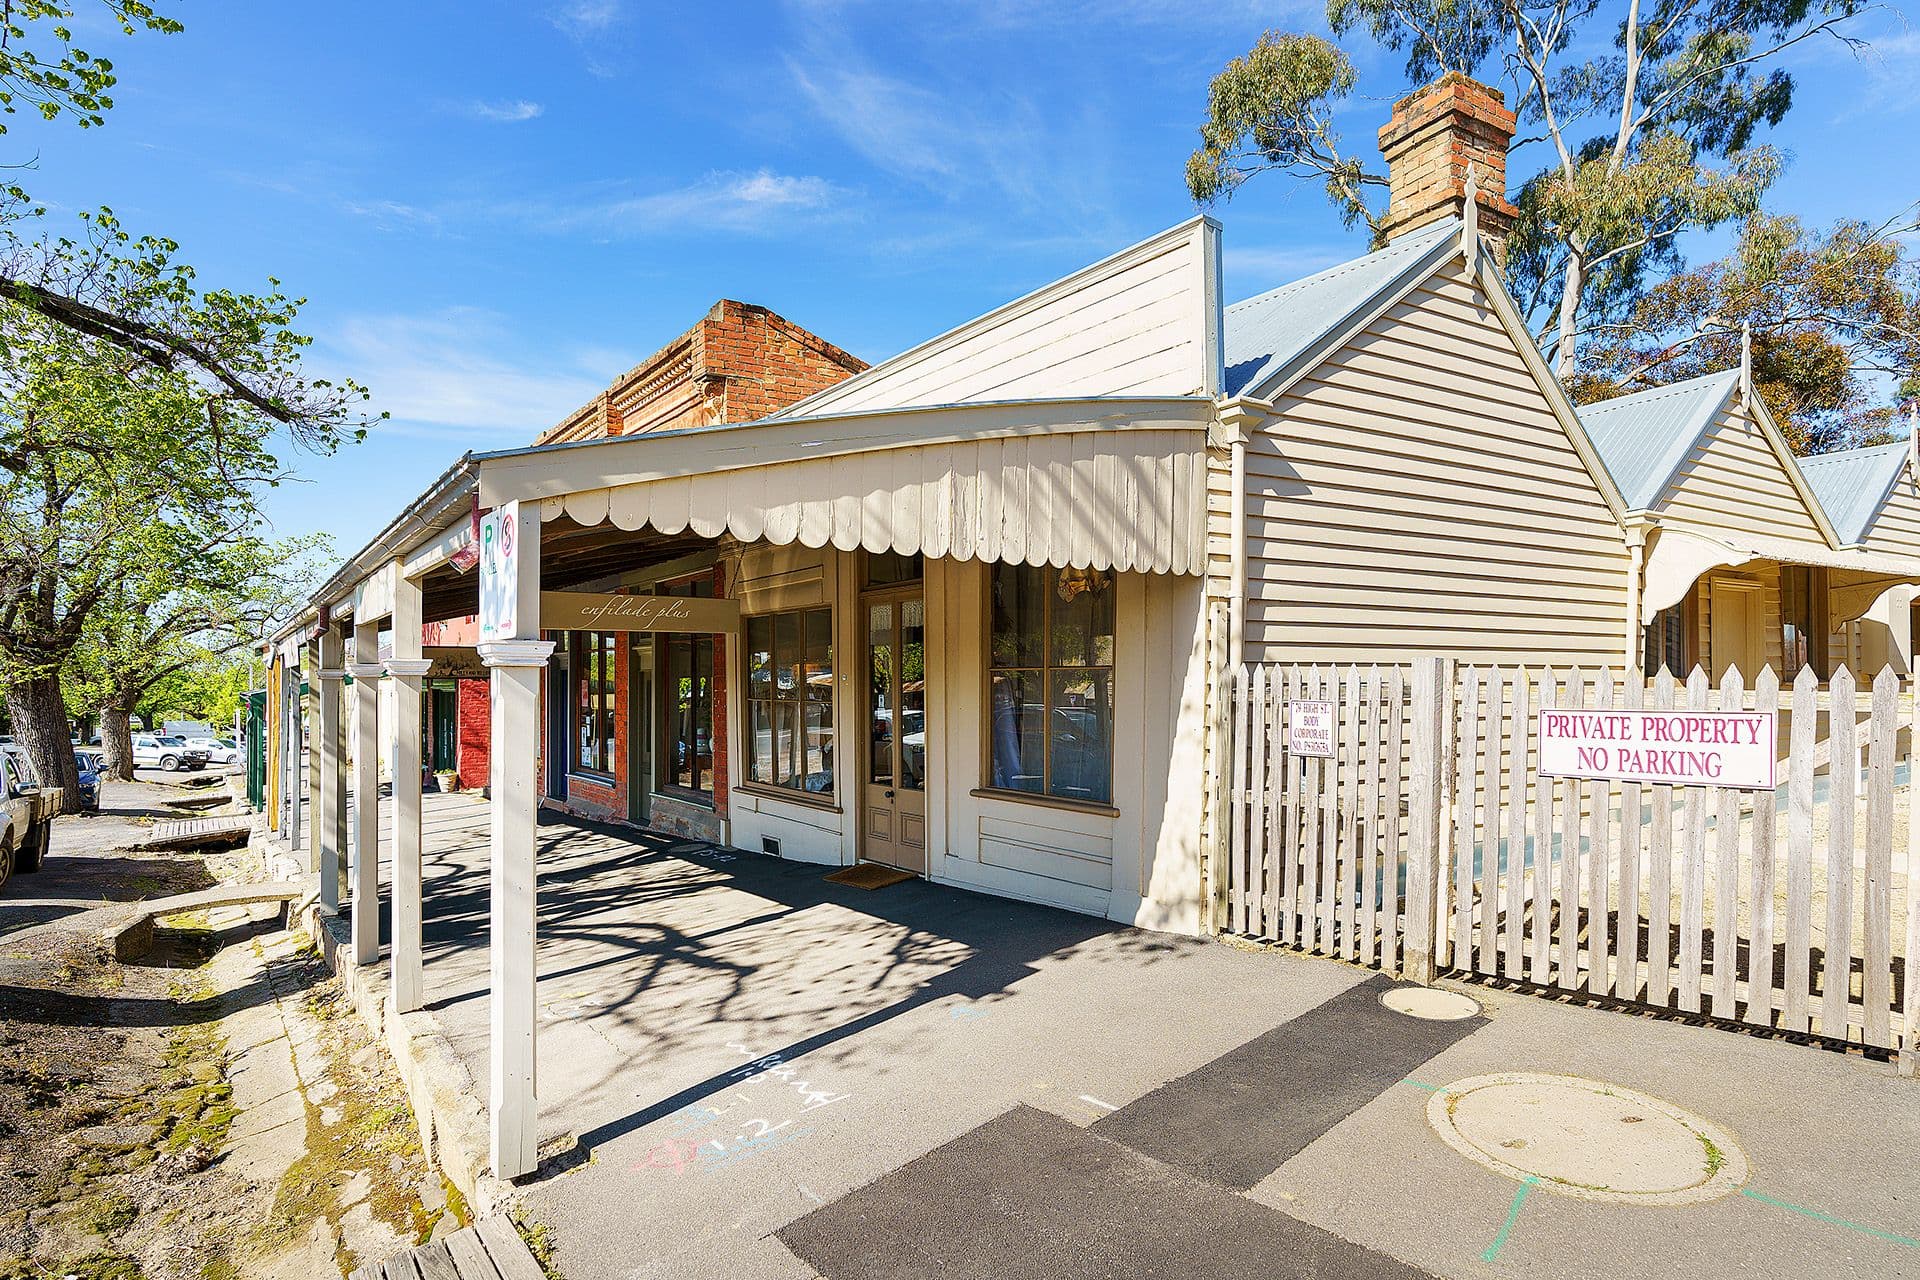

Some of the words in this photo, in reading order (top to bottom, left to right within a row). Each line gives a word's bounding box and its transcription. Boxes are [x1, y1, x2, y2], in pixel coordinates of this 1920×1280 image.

[571, 594, 656, 630] enfilade
[642, 599, 691, 630] plus
[1303, 703, 1319, 714] HIGH
[1303, 715, 1320, 727] BODY
[1546, 714, 1632, 741] PRIVATE
[1641, 716, 1763, 745] PROPERTY
[1293, 727, 1329, 740] CORPORATE
[1577, 746, 1609, 772] NO
[1617, 748, 1722, 778] PARKING
